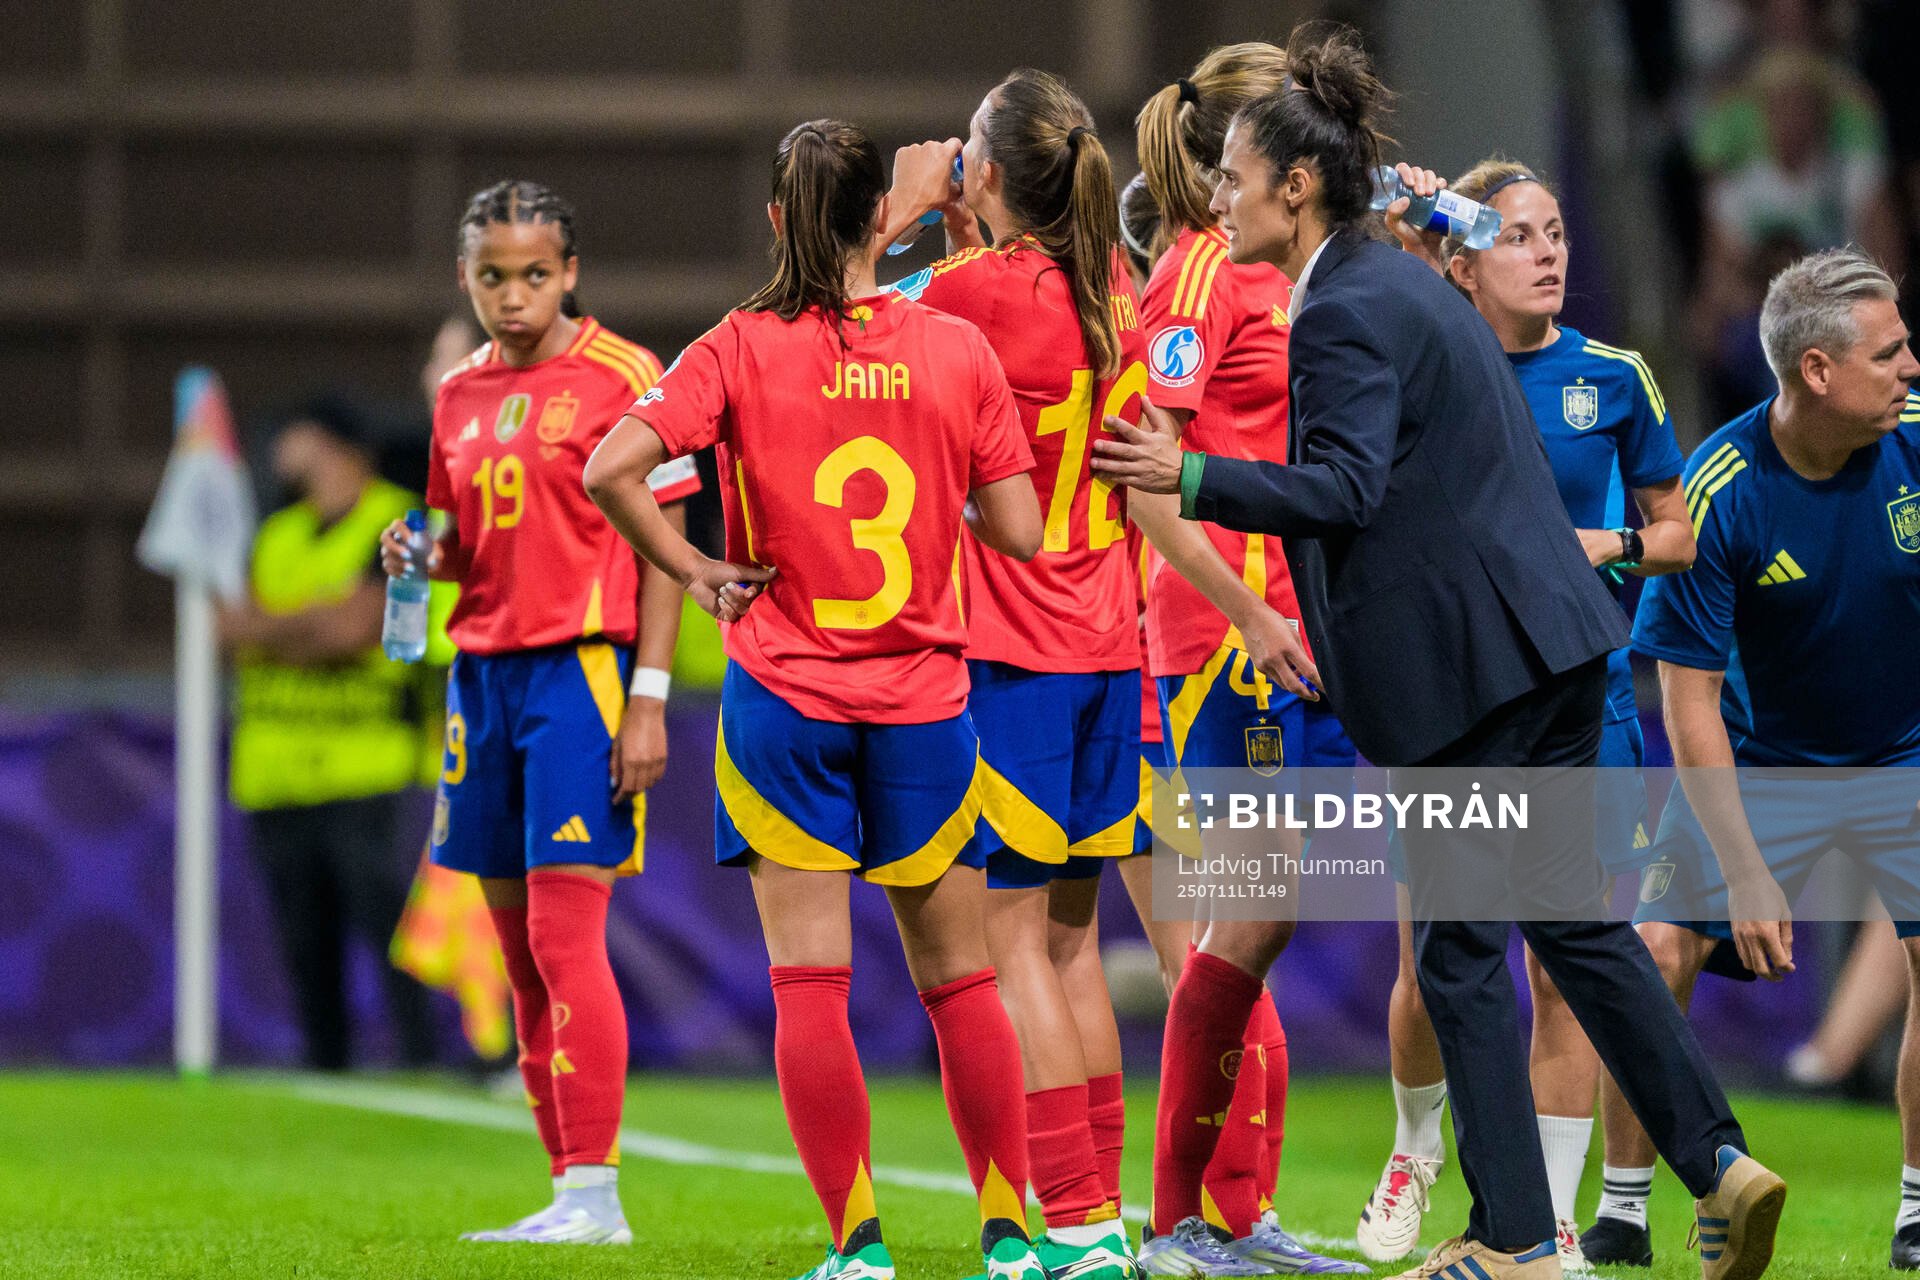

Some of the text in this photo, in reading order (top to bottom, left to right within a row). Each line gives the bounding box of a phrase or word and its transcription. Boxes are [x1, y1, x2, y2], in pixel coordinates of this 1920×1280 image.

[821, 361, 910, 400] JANA
[472, 454, 525, 529] 19
[812, 435, 916, 630] 3
[1228, 649, 1273, 710] 4
